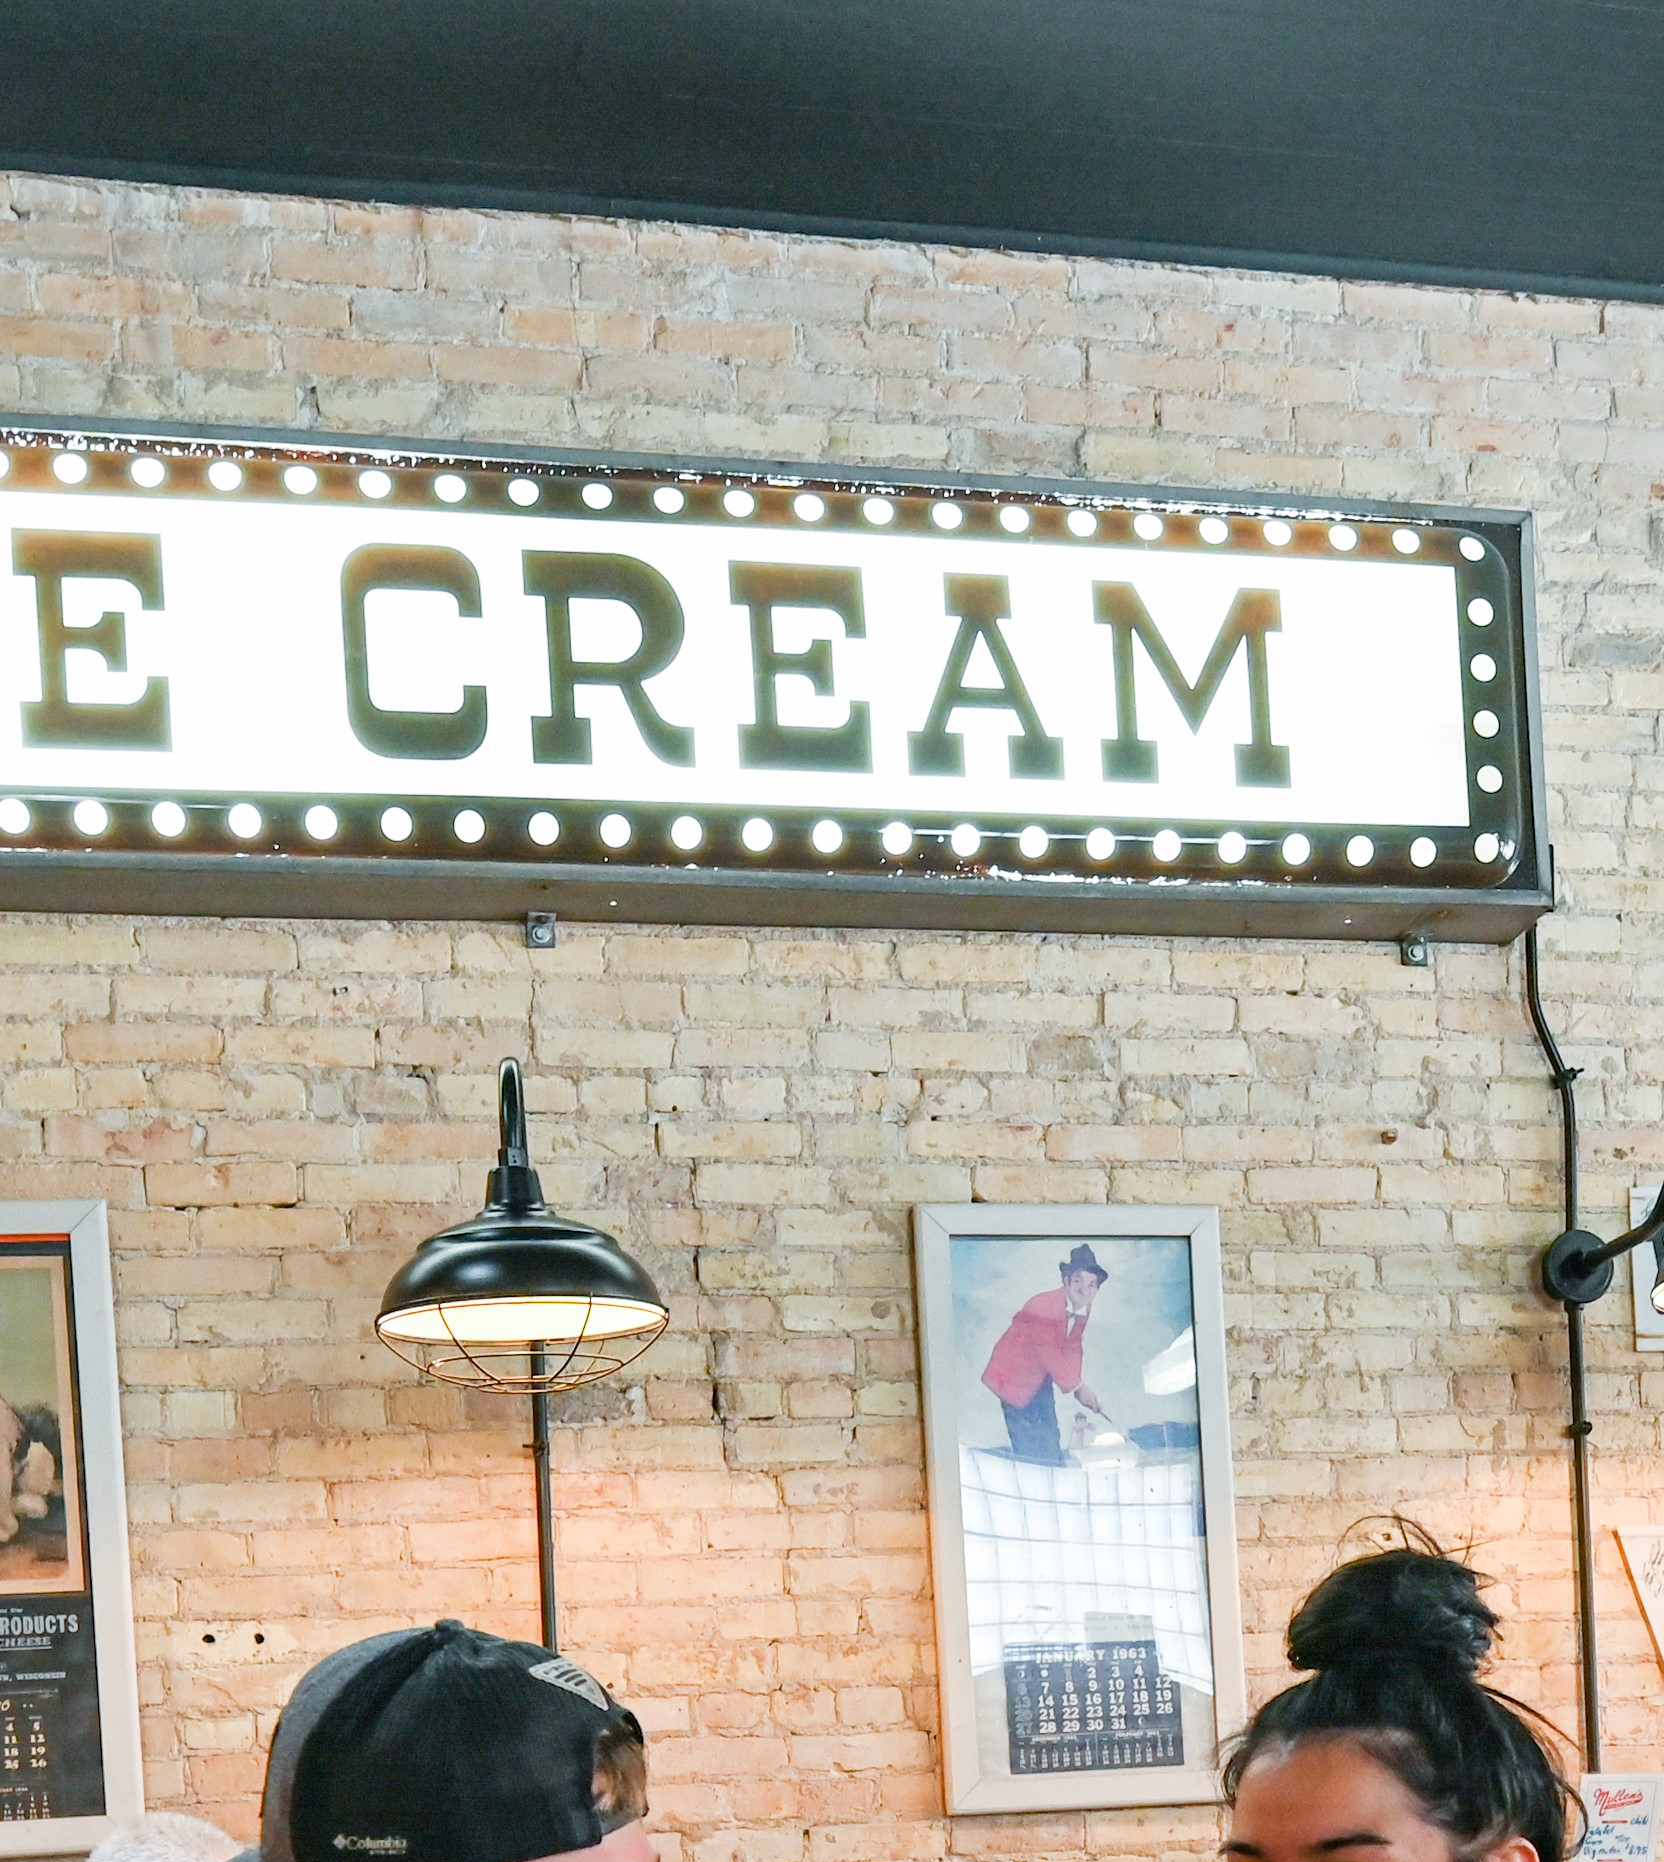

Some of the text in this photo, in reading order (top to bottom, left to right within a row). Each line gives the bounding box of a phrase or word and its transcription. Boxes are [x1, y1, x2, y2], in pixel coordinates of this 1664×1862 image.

[336, 541, 1293, 789] CREAM
[1036, 1648, 1146, 1664] JANUARY 1963
[1088, 1667, 1096, 1678] 2
[1112, 1666, 1120, 1677] 3
[1135, 1666, 1143, 1676] 4
[1041, 1682, 1049, 1694] 7
[1065, 1682, 1074, 1692] 8
[1089, 1681, 1097, 1691] 9
[1109, 1680, 1124, 1690] 10
[1133, 1679, 1146, 1689] 11
[1156, 1677, 1171, 1688] 12
[1038, 1695, 1054, 1707] 14
[1062, 1694, 1078, 1705] 15
[1085, 1693, 1102, 1704] 16
[1109, 1692, 1124, 1703] 17
[1133, 1691, 1148, 1702] 18
[1156, 1690, 1171, 1701] 19
[1039, 1708, 1055, 1720] 21
[1063, 1707, 1080, 1719] 22
[1086, 1706, 1103, 1717] 23
[1110, 1705, 1126, 1716] 24
[1133, 1704, 1149, 1715] 25
[1157, 1703, 1173, 1714] 26
[5, 1723, 13, 1732] 4
[1040, 1721, 1056, 1733] 28
[1063, 1720, 1080, 1732] 29
[1087, 1719, 1103, 1730] 30
[1111, 1718, 1126, 1729] 31
[4, 1736, 17, 1744] 11
[30, 1734, 45, 1743] 12
[4, 1748, 19, 1757] 18
[31, 1747, 45, 1756] 19
[30, 1759, 47, 1768] 26
[1594, 1788, 1644, 1816] Mullen's
